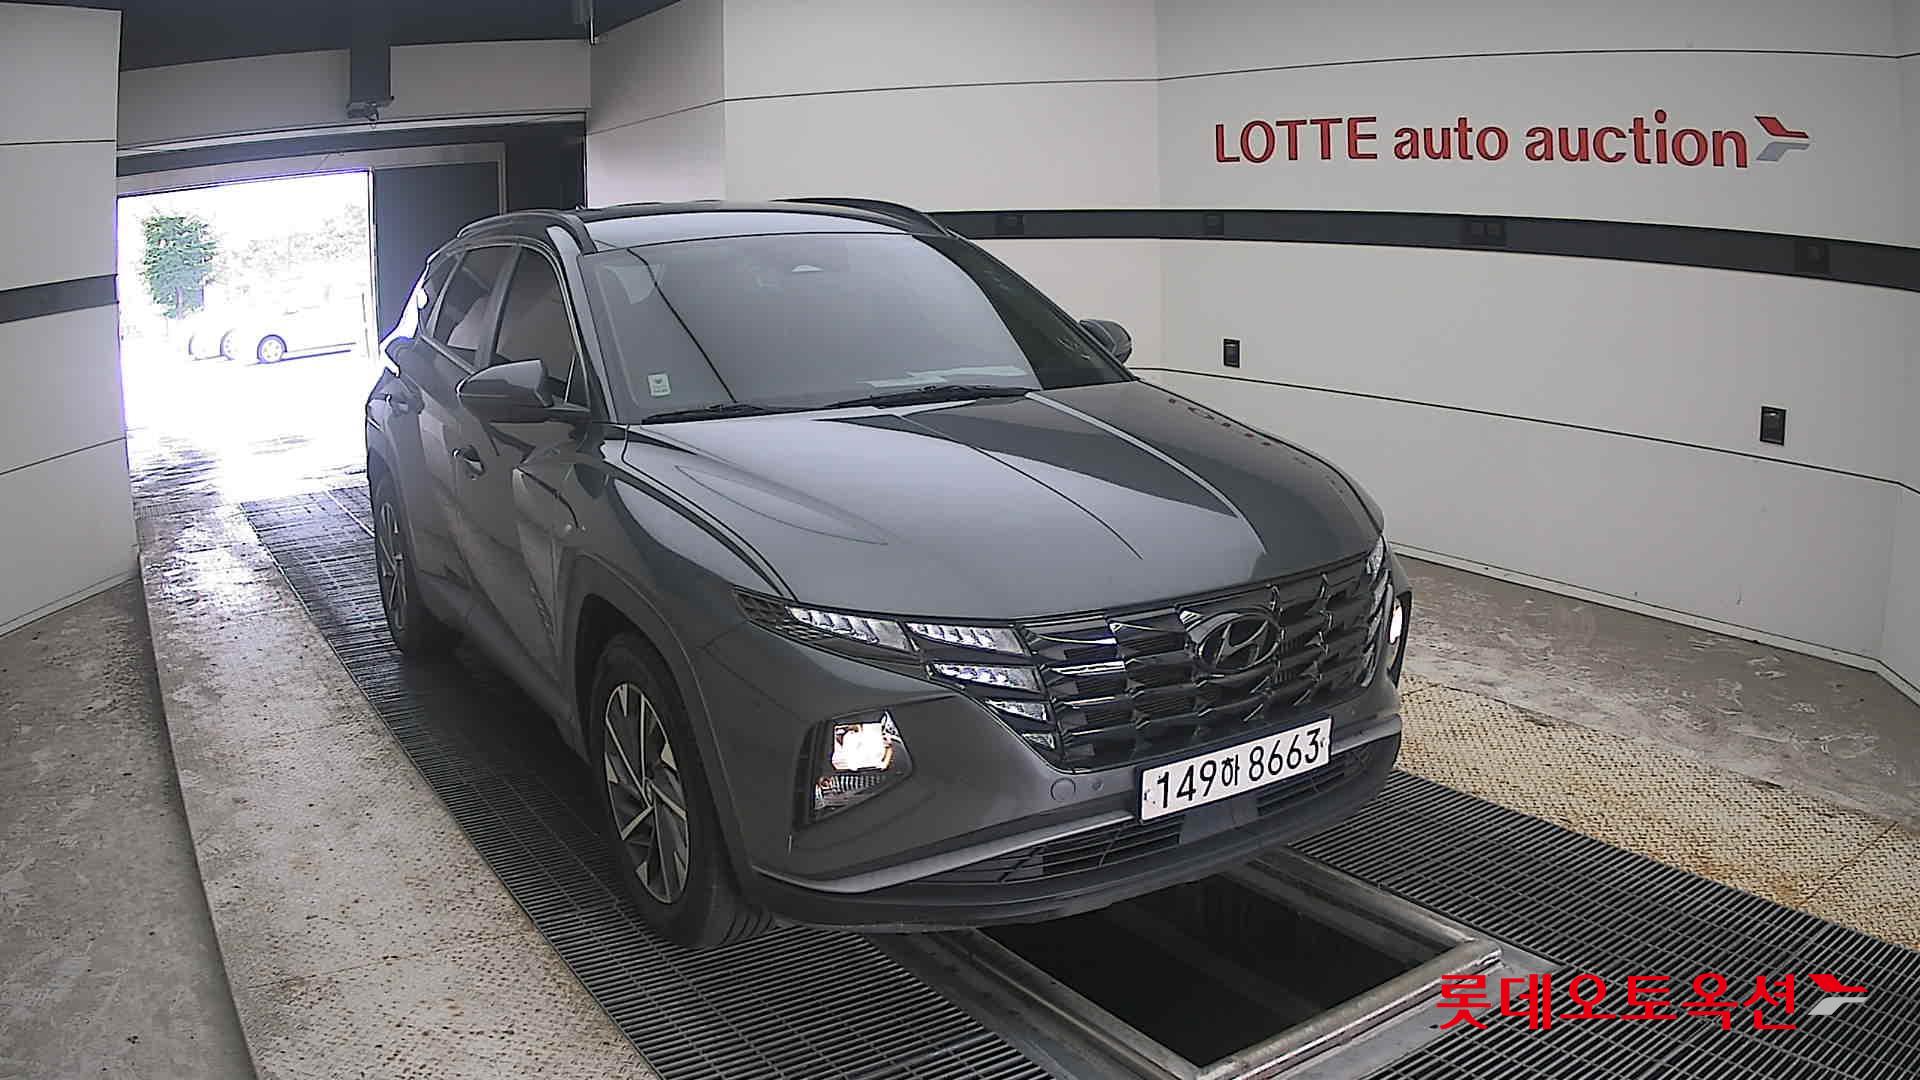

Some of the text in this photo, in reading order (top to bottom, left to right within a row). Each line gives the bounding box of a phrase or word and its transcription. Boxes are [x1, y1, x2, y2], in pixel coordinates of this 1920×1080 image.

[1214, 109, 1749, 168] LOTTE auto auction
[1157, 727, 1321, 809] 149하 8663
